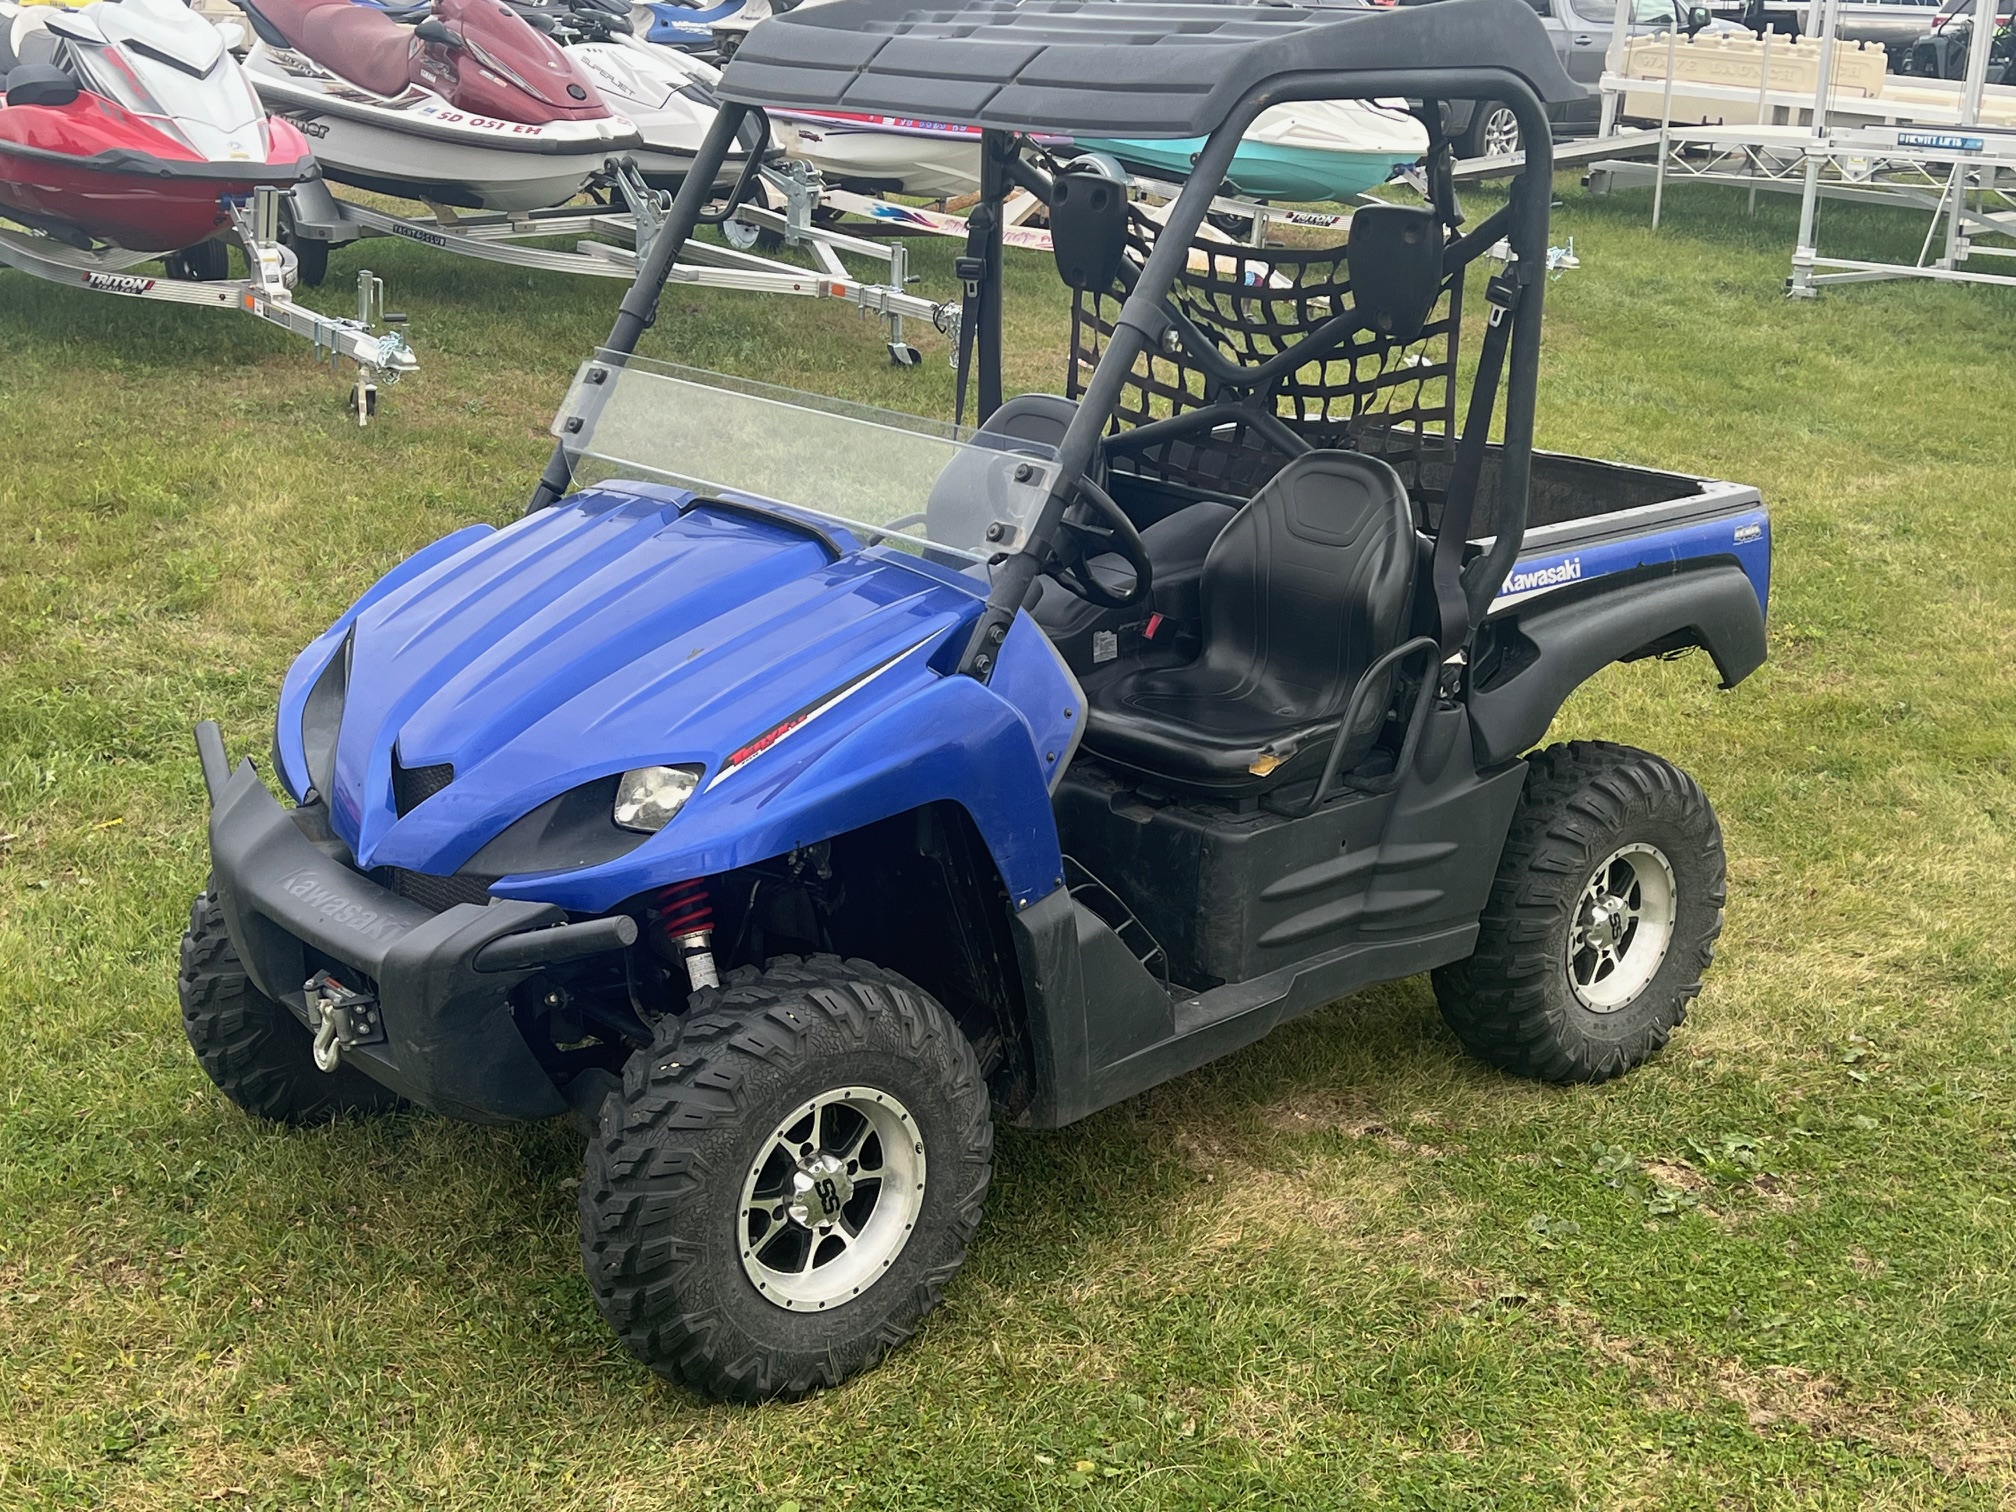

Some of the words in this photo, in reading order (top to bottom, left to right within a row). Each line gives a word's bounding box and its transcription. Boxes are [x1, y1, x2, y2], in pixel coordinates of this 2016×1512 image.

[581, 55, 636, 96] SUPERJET
[437, 111, 464, 122] SD
[512, 125, 543, 135] EH
[394, 225, 416, 238] YACHT
[88, 272, 149, 290] TRITON
[1502, 557, 1581, 594] Kawasaki
[275, 867, 412, 943] Kawasaki
[815, 1178, 840, 1214] SS
